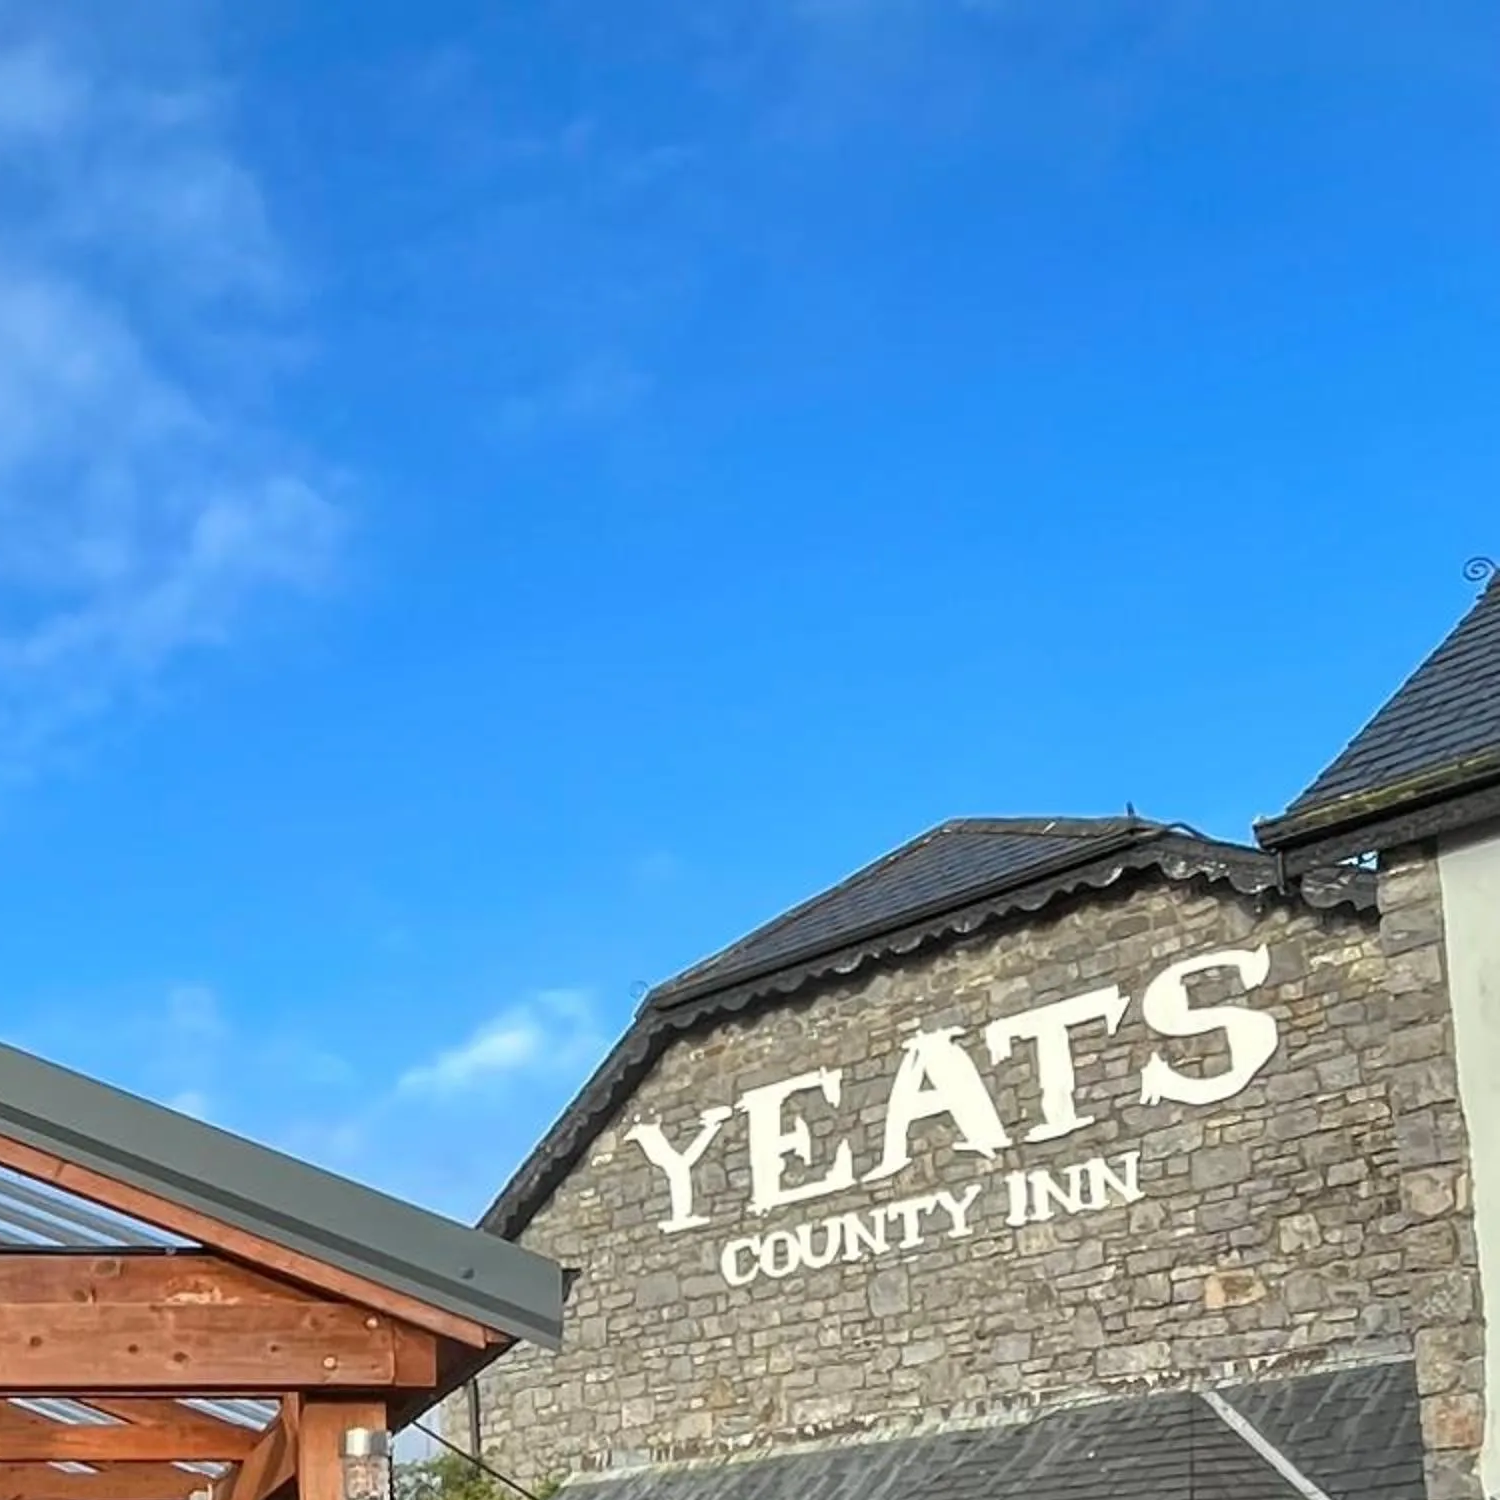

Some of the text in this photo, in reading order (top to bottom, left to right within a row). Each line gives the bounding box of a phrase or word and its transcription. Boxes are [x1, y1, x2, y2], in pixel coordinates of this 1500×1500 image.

[625, 943, 1279, 1233] YEATS
[721, 1151, 1145, 1286] COUNTY INN
